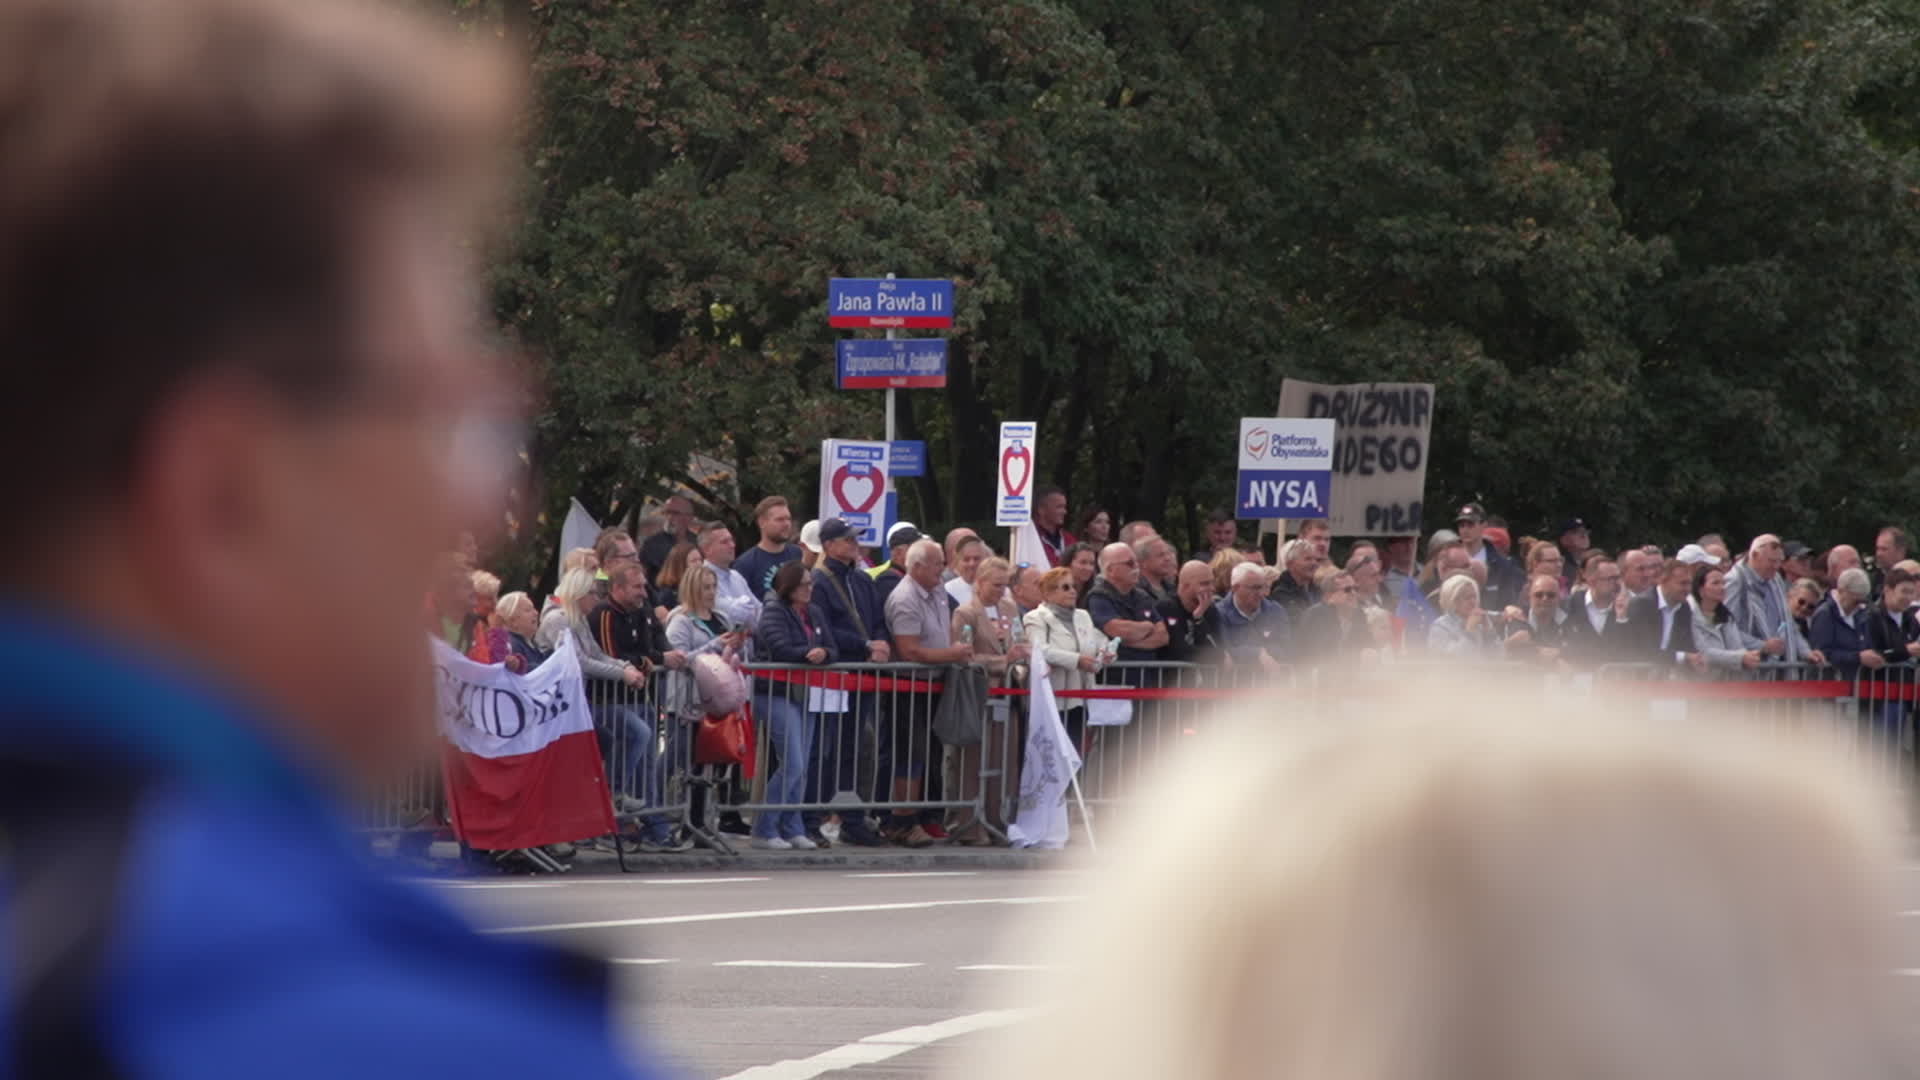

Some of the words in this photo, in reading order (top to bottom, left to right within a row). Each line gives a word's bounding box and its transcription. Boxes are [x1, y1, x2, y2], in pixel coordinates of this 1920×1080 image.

[837, 291, 872, 311] Jana
[877, 291, 926, 311] Pawła
[932, 292, 943, 311] II
[1271, 433, 1317, 446] Platforma
[1270, 445, 1329, 460] Obywatelska
